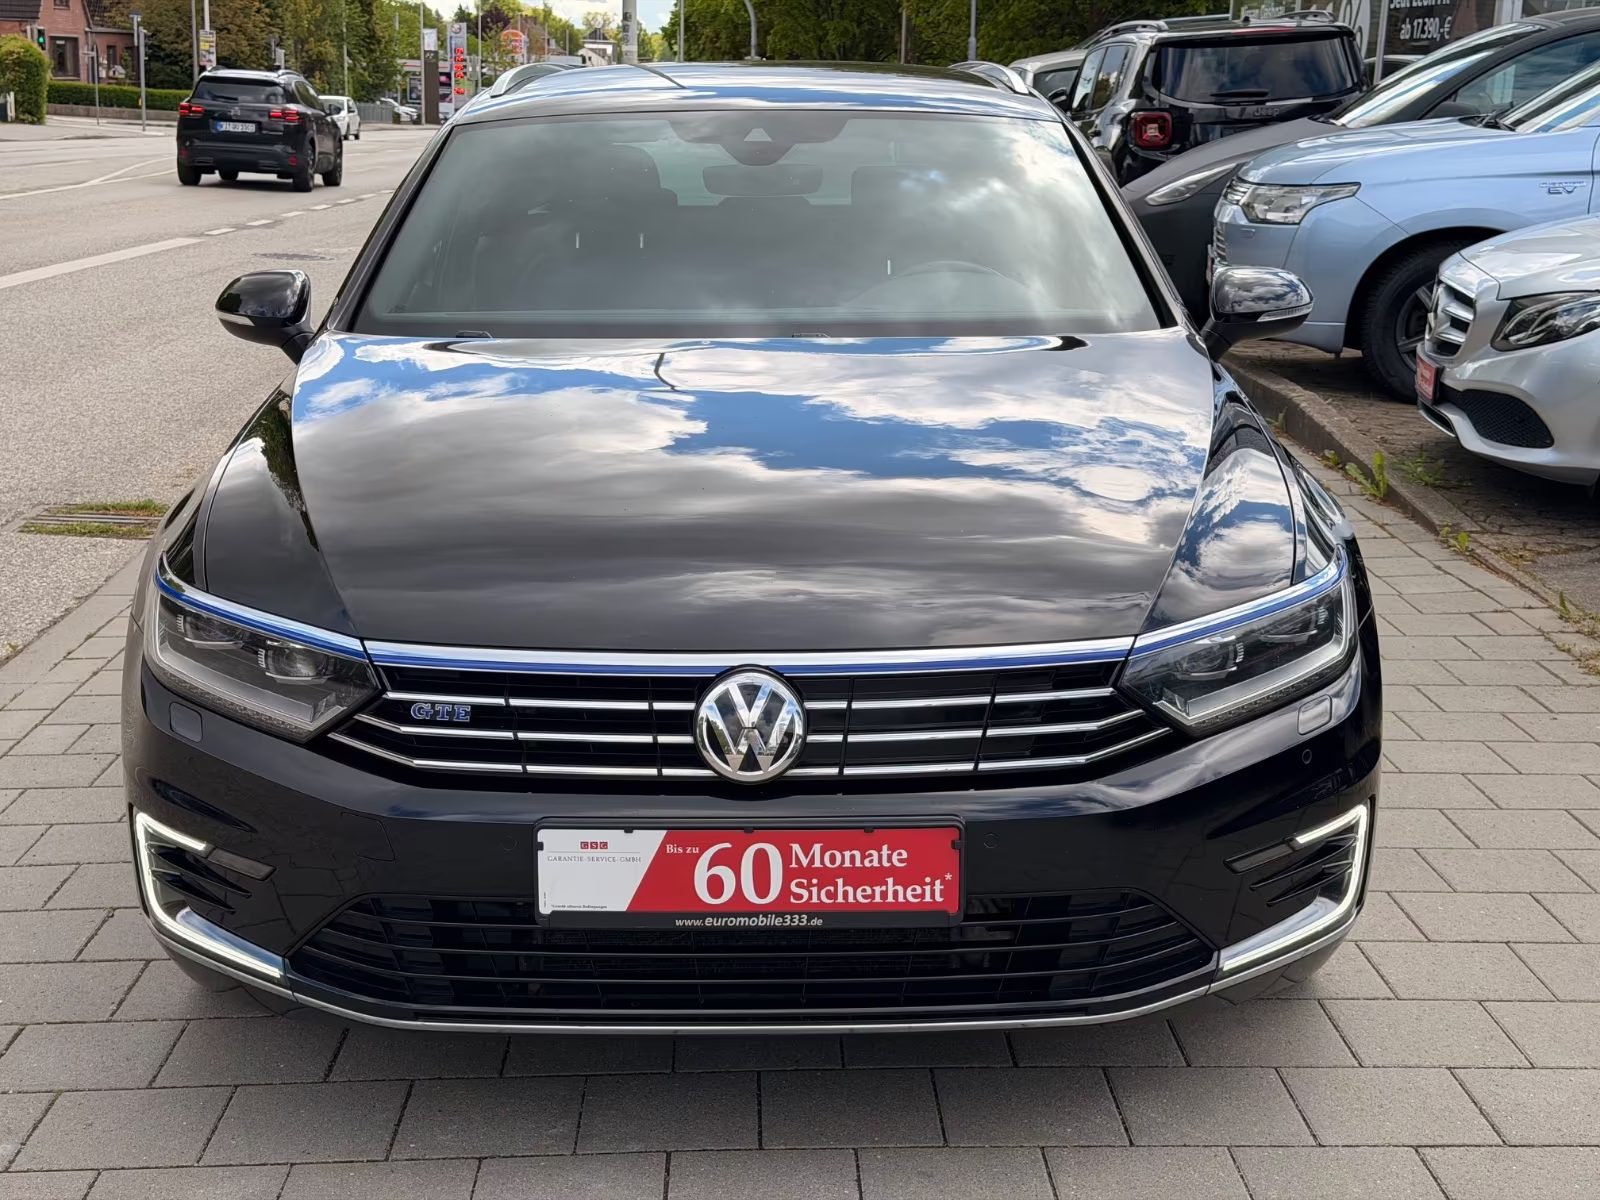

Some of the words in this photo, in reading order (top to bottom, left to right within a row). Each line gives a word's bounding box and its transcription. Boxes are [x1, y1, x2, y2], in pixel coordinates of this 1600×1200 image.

[1400, 18, 1411, 40] ab
[1254, 107, 1280, 117] Jeep
[411, 703, 471, 722] GTE
[580, 841, 608, 849] GSG
[666, 844, 683, 854] Bis
[686, 845, 699, 854] zu
[789, 843, 908, 868] Monate
[694, 842, 783, 905] 60
[675, 914, 823, 927] www.euromobile333.de
